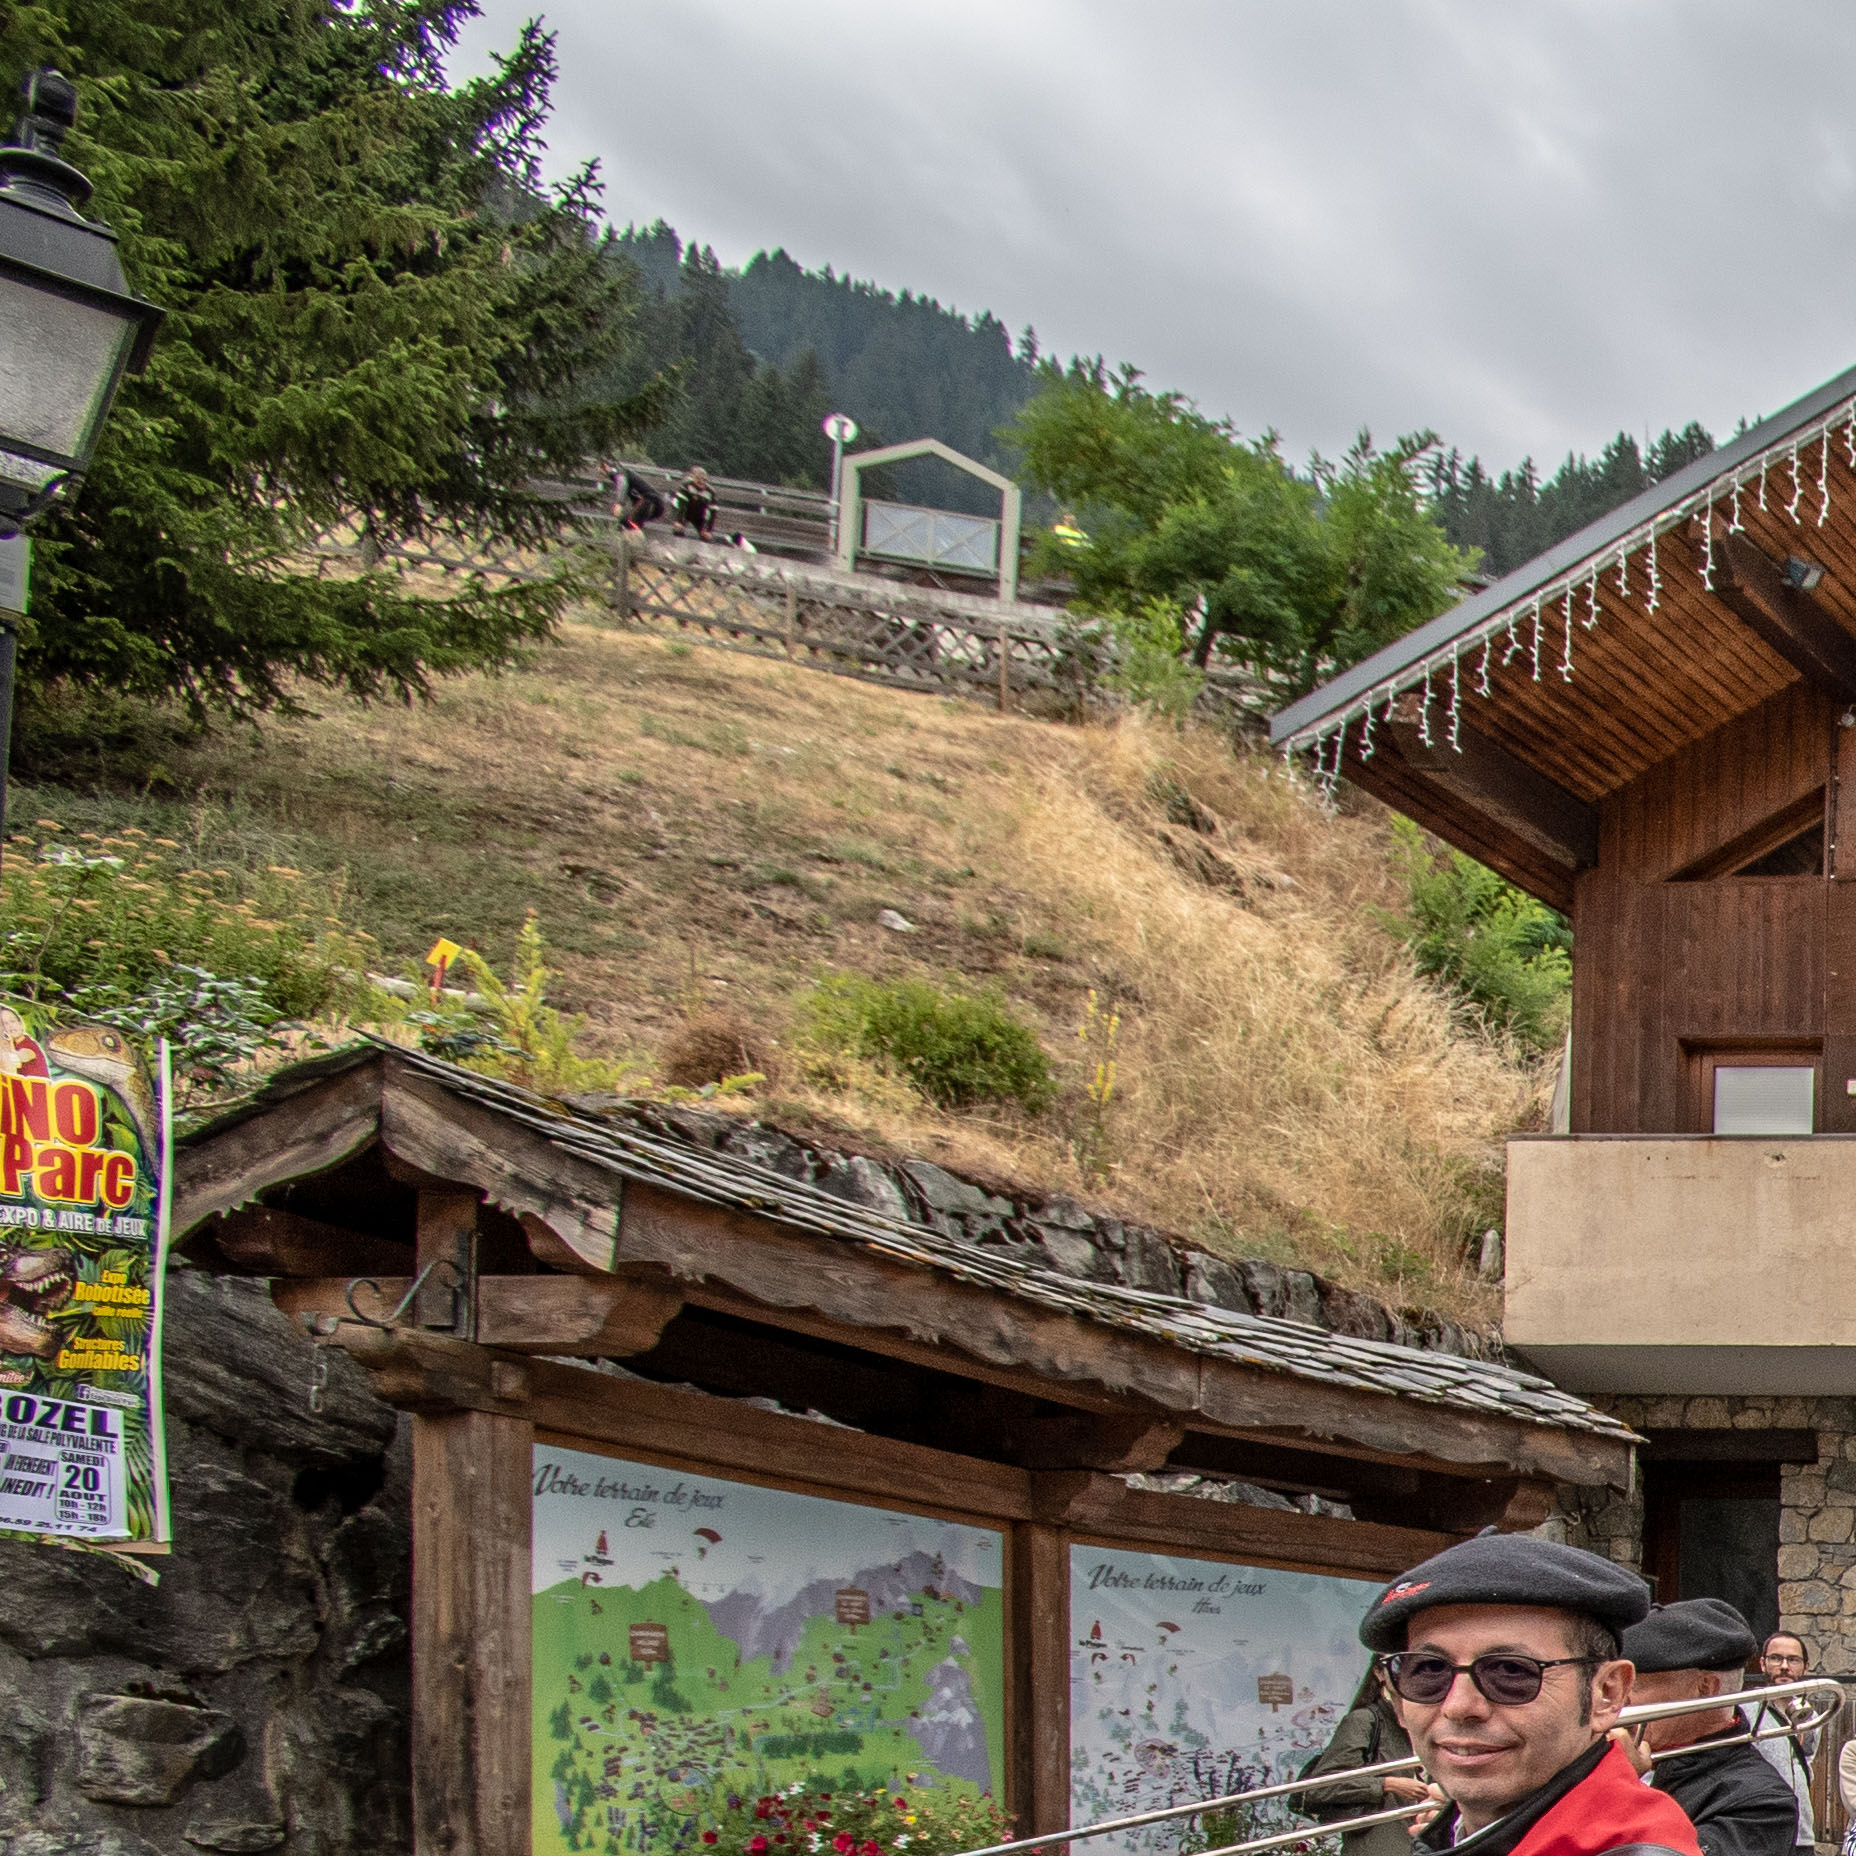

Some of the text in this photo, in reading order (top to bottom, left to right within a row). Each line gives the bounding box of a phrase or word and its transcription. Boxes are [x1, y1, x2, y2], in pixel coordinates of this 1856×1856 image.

[4, 1133, 135, 1206] Parc
[58, 1211, 94, 1231] AIRE
[0, 1395, 119, 1439] OZEL
[61, 1451, 105, 1467] SAMEDI
[64, 1464, 101, 1492] 20
[534, 1463, 592, 1497] Votre
[59, 1490, 107, 1502] AOUT
[1088, 1563, 1141, 1591] Votre
